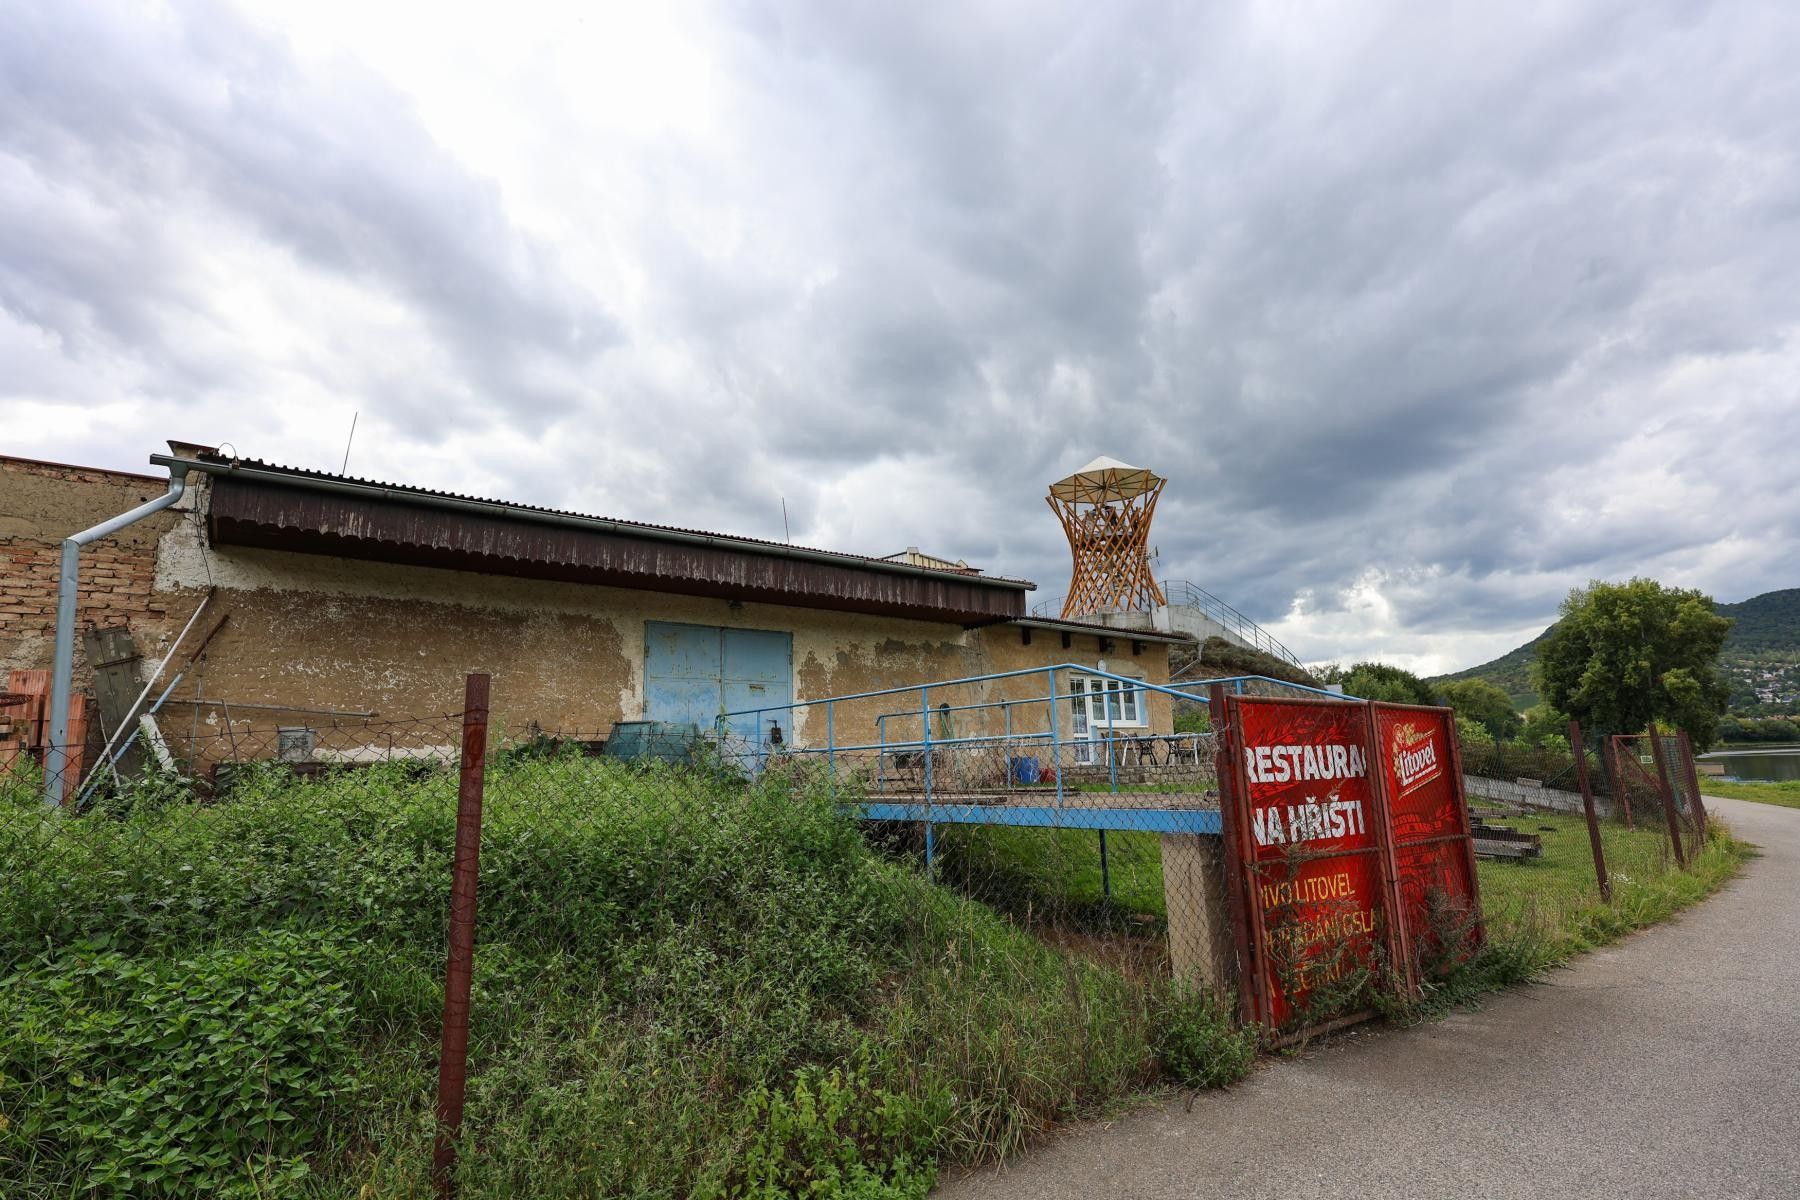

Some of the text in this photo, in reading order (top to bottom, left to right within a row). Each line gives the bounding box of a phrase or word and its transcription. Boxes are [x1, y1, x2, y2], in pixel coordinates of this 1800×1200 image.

[1399, 738, 1437, 787] Litovel
[1252, 793, 1366, 846] NA HŘIŠTI
[1260, 873, 1355, 909] IVO LITOVEL
